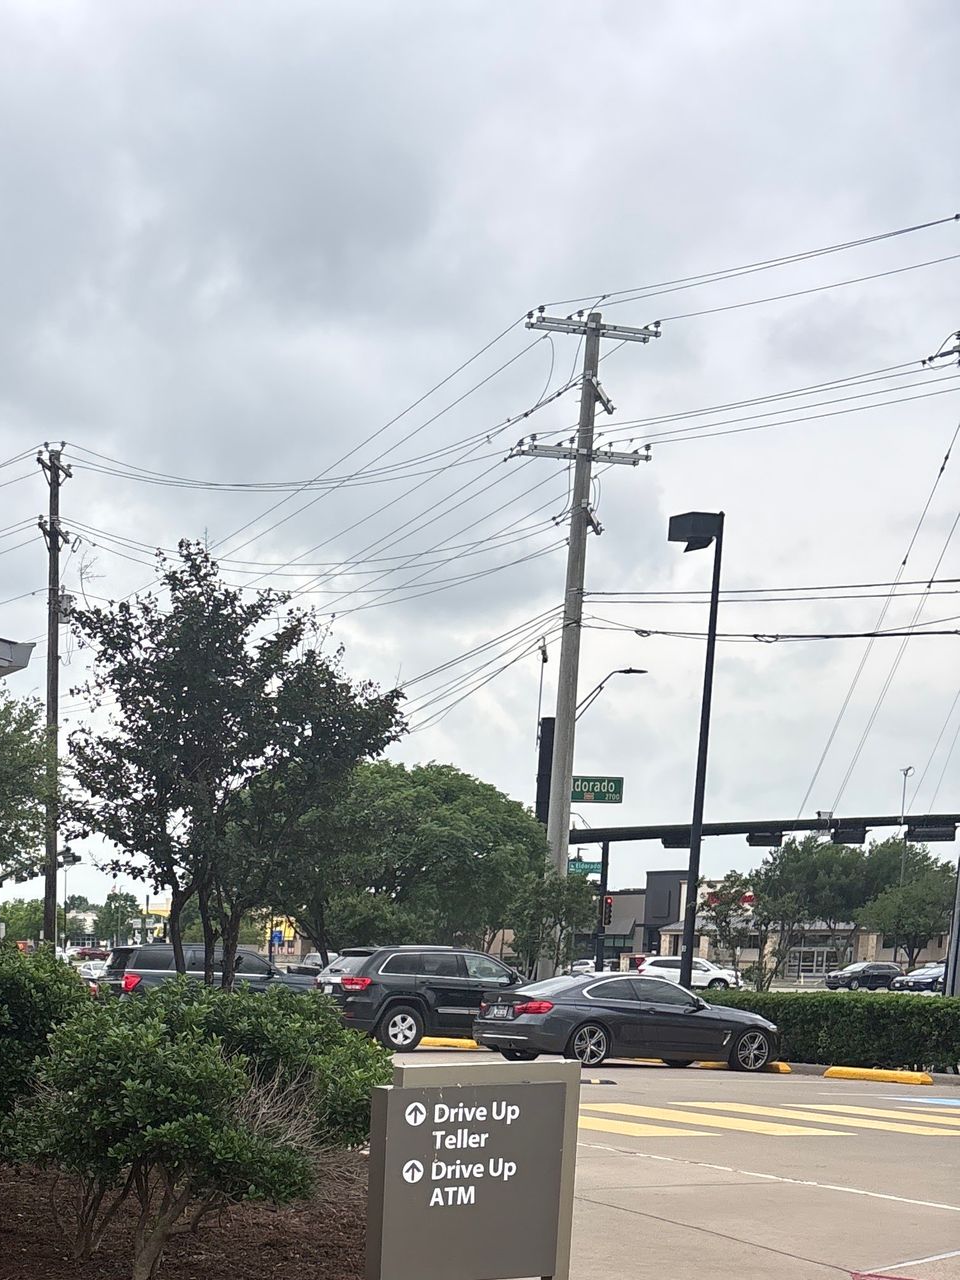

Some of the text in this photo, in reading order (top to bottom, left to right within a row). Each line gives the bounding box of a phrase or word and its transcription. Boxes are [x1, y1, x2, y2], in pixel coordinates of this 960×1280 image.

[433, 1101, 520, 1125] Drive Up
[432, 1128, 489, 1150] Teller
[431, 1157, 517, 1181] Drive Up
[429, 1185, 476, 1207] ATM
